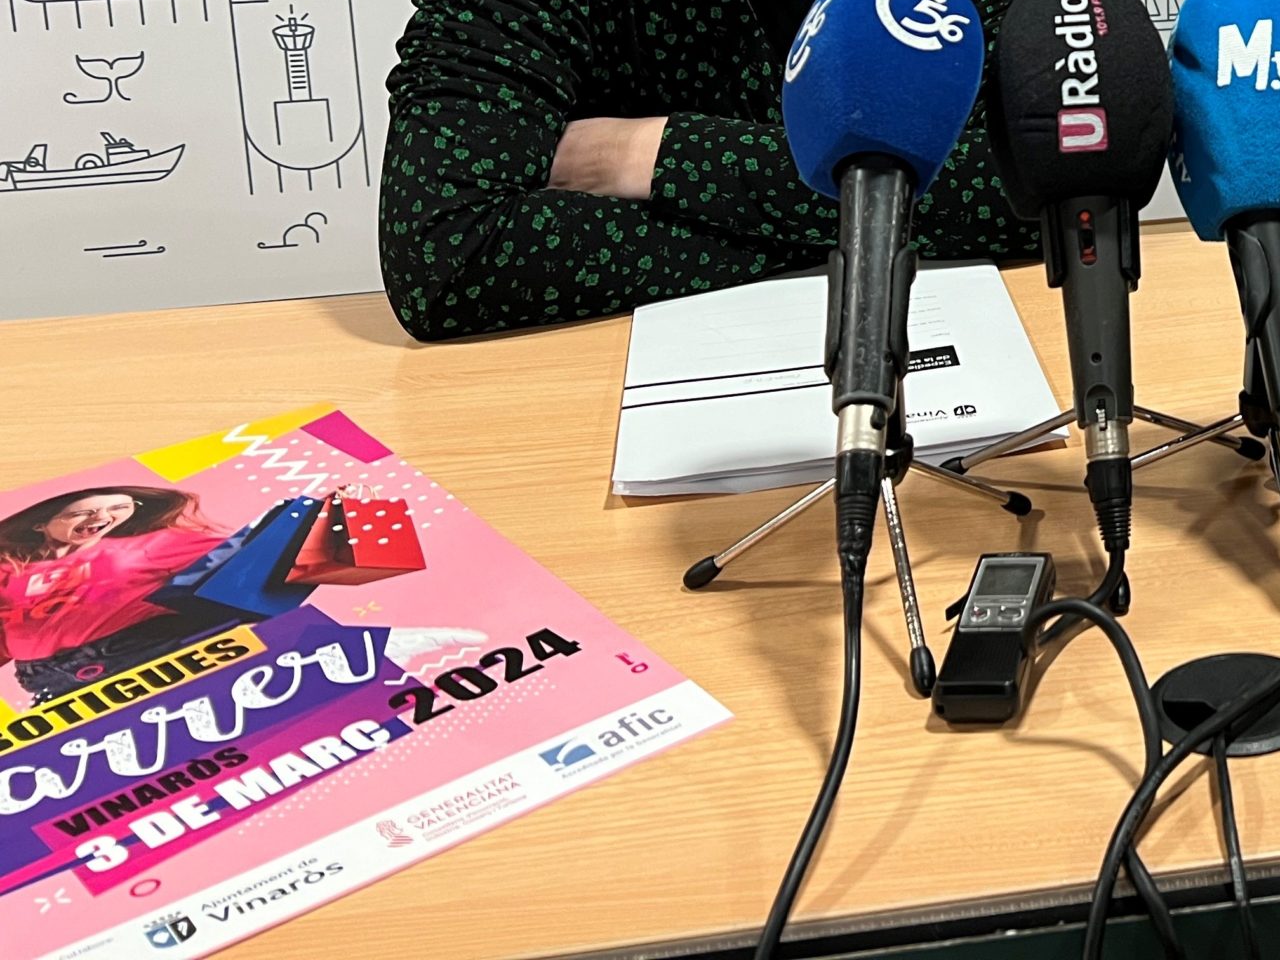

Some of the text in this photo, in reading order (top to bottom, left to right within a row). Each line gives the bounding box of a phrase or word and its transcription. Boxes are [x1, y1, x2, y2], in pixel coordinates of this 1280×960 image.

[907, 359, 952, 370] Expedie
[906, 409, 947, 419] Vina
[0, 630, 376, 815] arrer
[598, 708, 674, 748] afic
[75, 628, 582, 873] 3 DE MARÇ 2024
[53, 746, 249, 837] VINARÒS
[406, 772, 515, 824] GENERALITAT
[414, 781, 522, 830] VALENCIANA
[206, 861, 345, 923] Vinaròs
